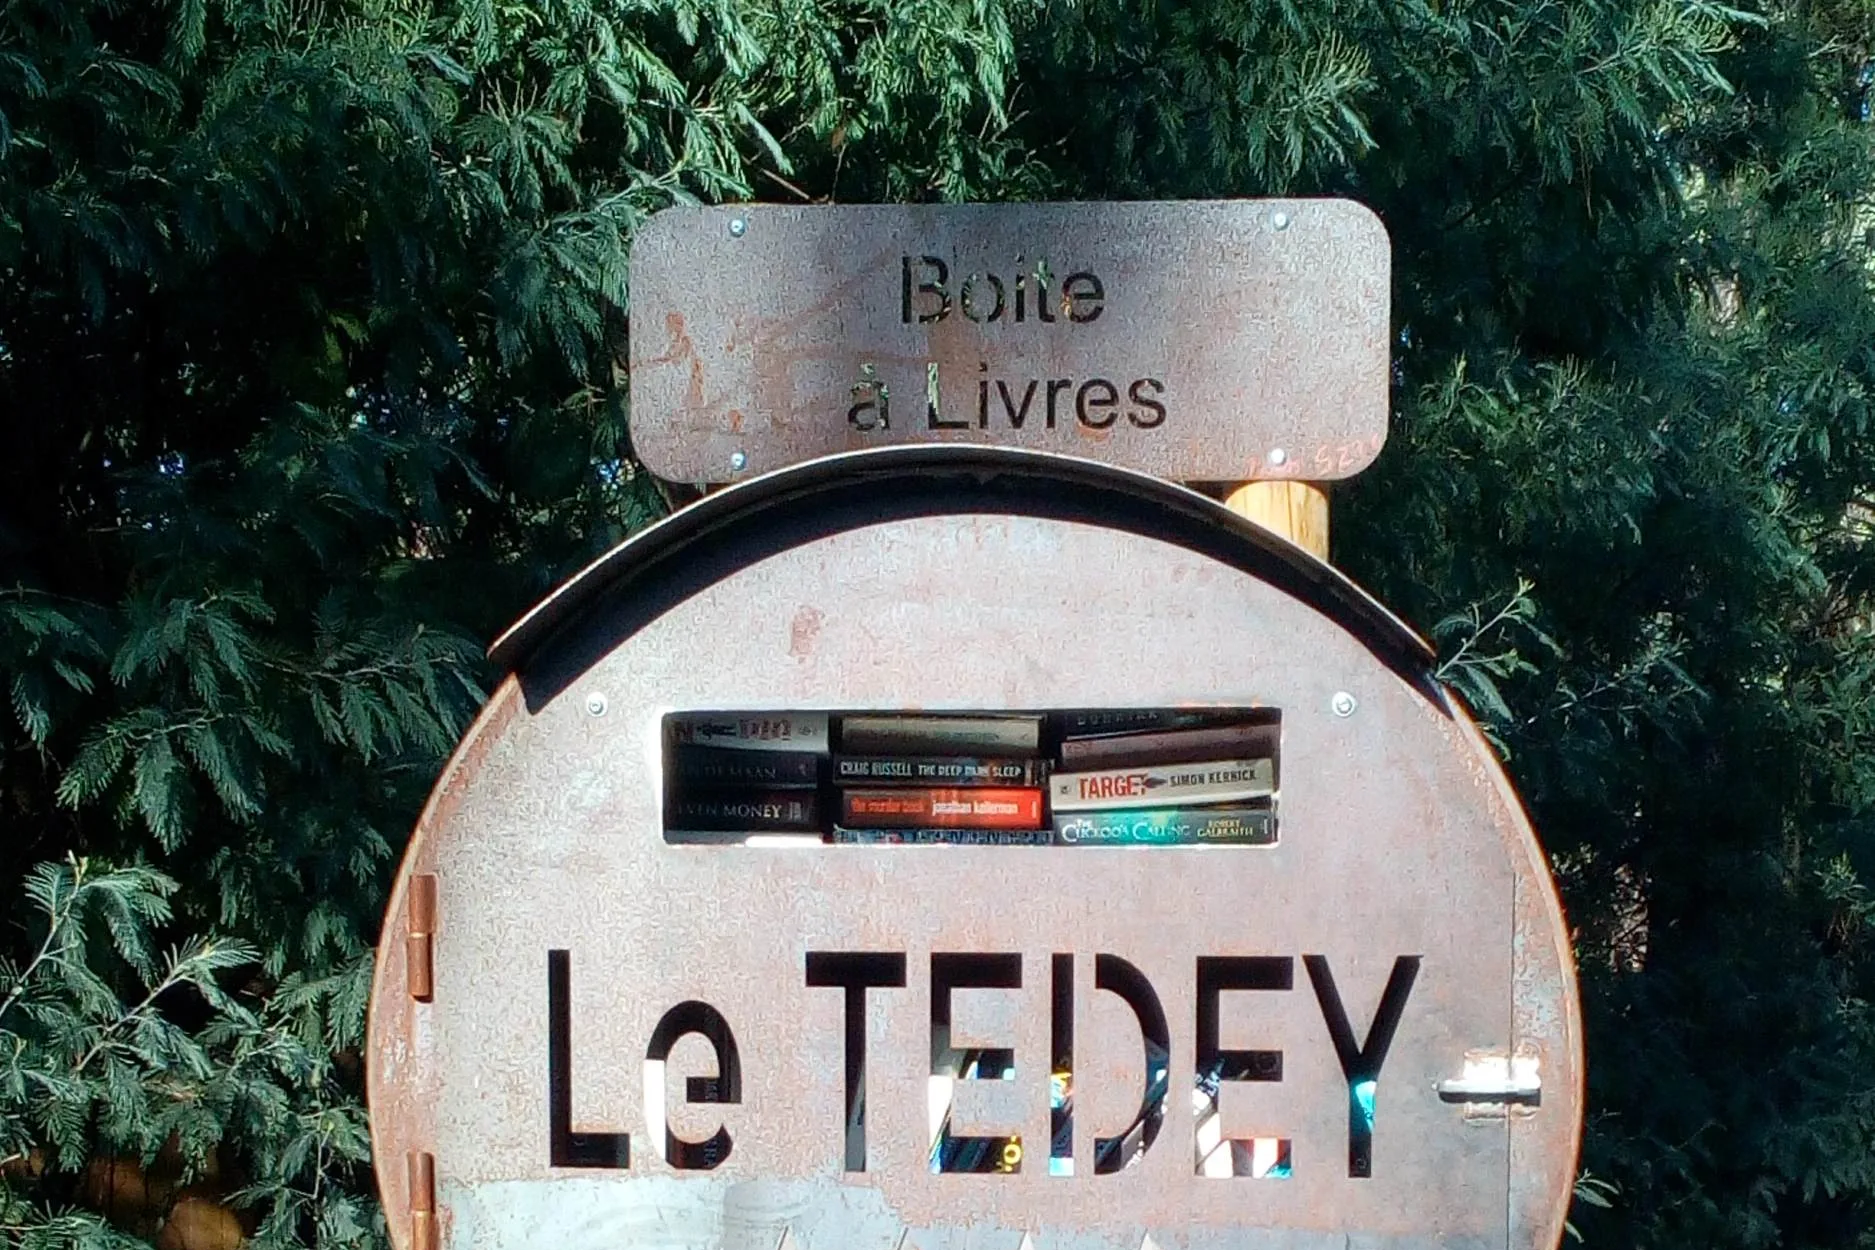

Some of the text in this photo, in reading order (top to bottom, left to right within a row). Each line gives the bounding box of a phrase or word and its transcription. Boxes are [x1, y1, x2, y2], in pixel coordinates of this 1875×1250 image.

[927, 362, 1167, 431] Livres
[840, 761, 869, 776] CRAIG
[871, 762, 912, 777] RUSSELL
[918, 764, 936, 776] THE
[938, 764, 963, 777] DEEP
[992, 763, 1022, 777] SLEEP
[1078, 769, 1257, 800] TARGET SIMON KERNICK
[722, 803, 783, 818] MONEY
[547, 949, 1424, 1179] Le TEDEY
